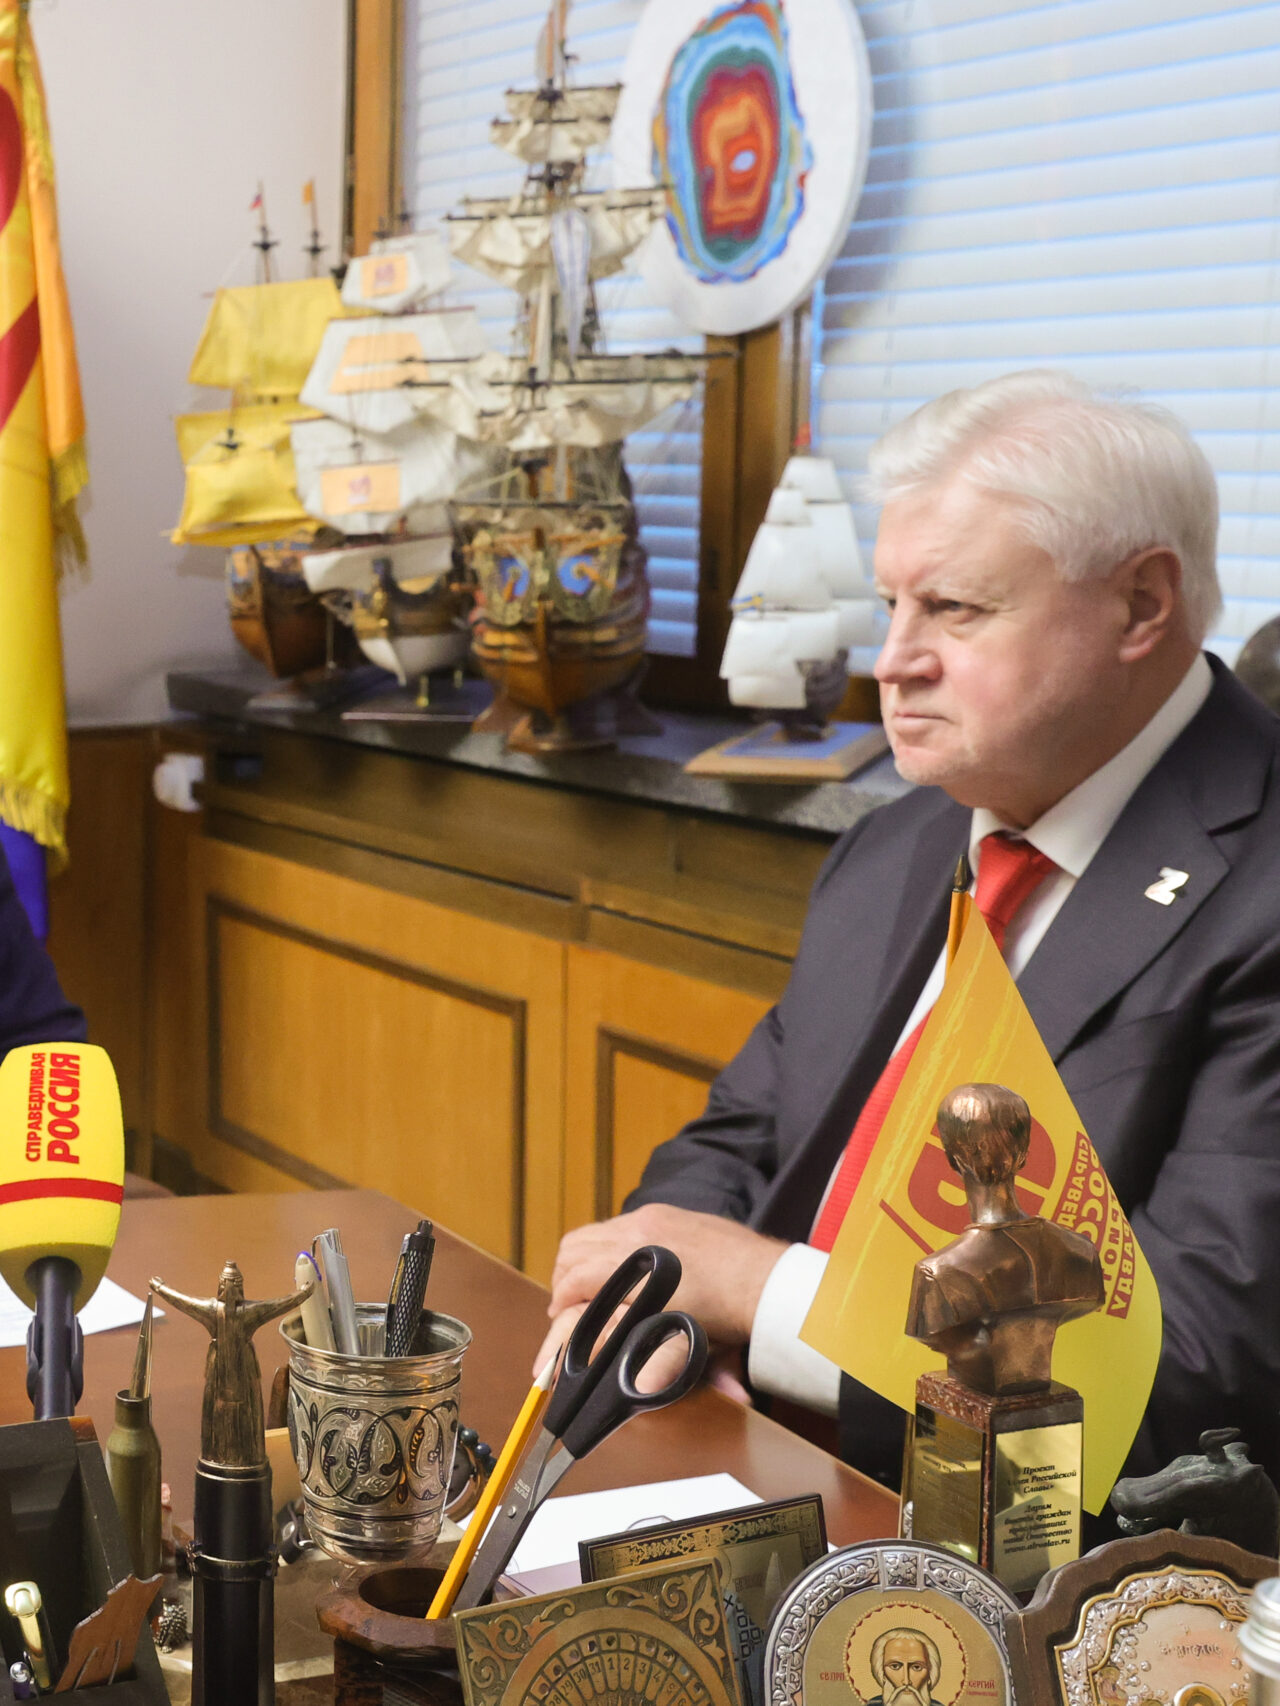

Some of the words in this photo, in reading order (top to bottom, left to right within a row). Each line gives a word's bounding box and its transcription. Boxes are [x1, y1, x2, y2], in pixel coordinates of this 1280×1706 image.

[25, 1052, 46, 1162] СПРАВЕДЛИВАЯ
[47, 1052, 81, 1165] РОССИЯ
[1023, 1465, 1055, 1475] Проект
[1031, 1469, 1077, 1483] Российской
[560, 1680, 573, 1696] 29
[573, 1667, 587, 1683] 30
[588, 1660, 601, 1675] 31
[608, 1656, 615, 1670] 1
[623, 1657, 631, 1670] 2
[639, 1662, 647, 1674] 3
[652, 1669, 662, 1682] 4
